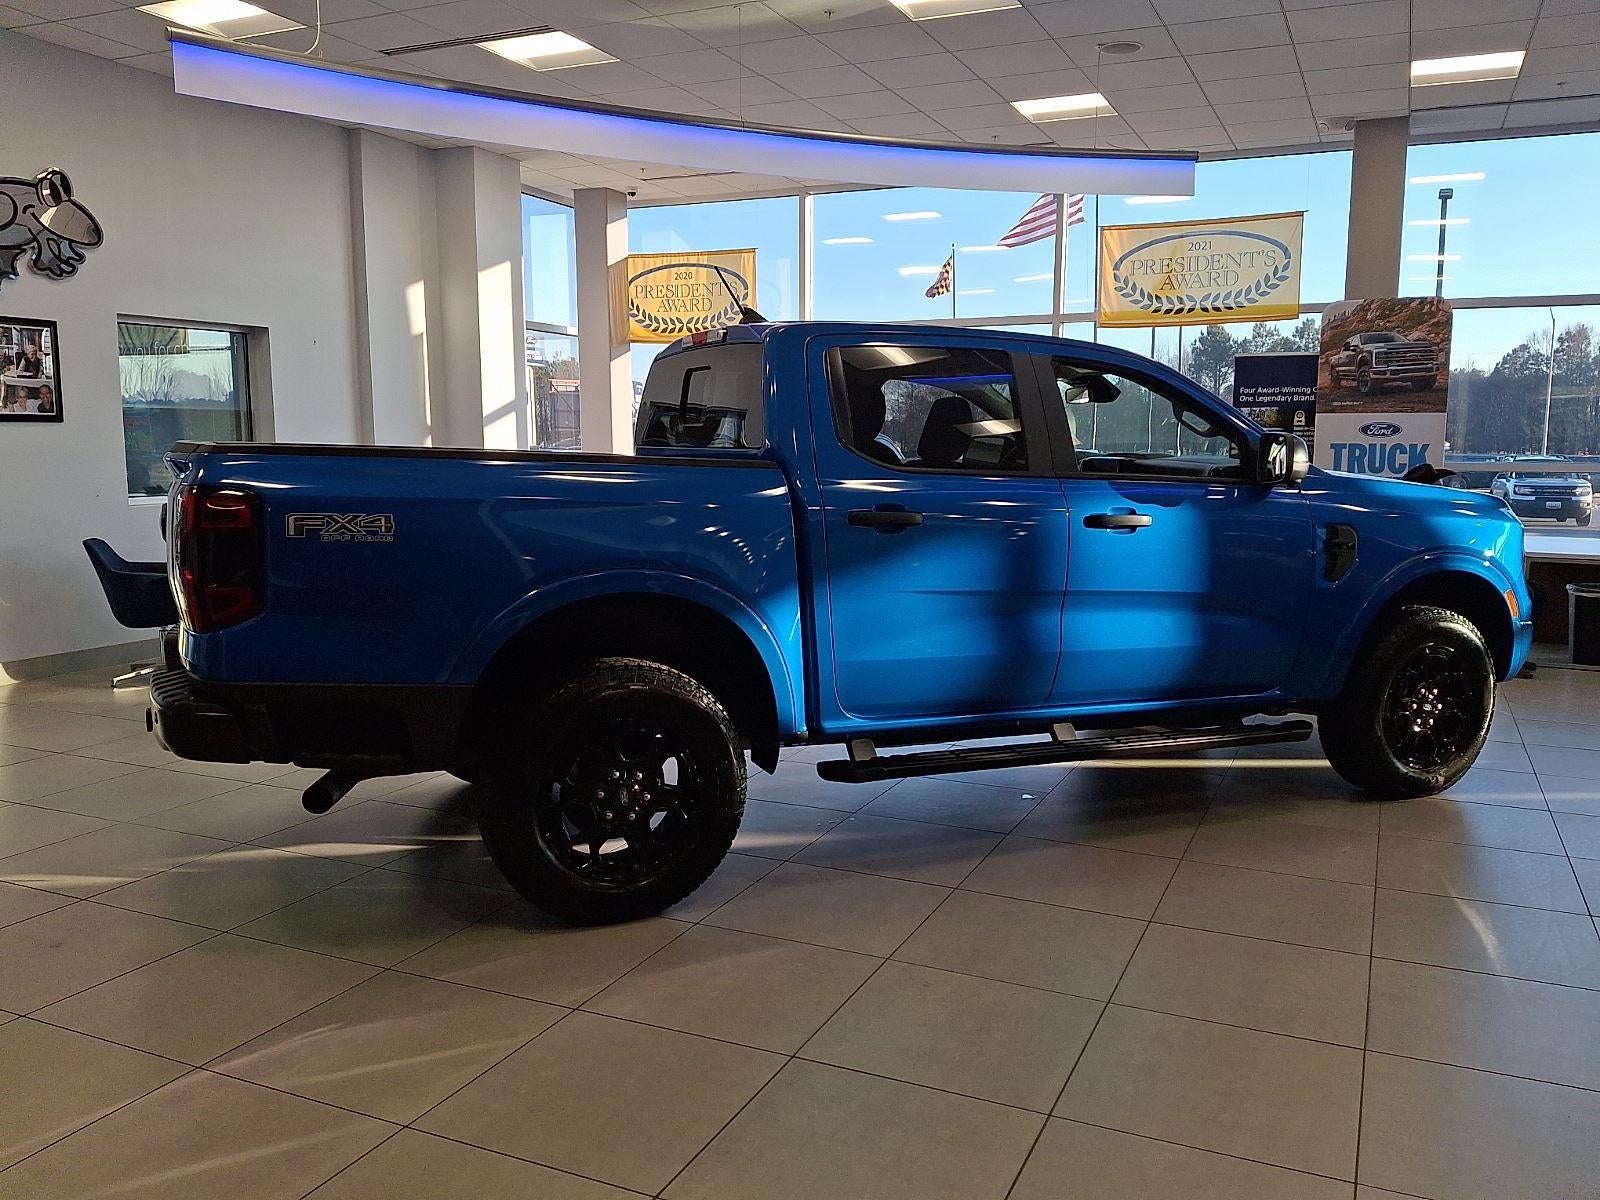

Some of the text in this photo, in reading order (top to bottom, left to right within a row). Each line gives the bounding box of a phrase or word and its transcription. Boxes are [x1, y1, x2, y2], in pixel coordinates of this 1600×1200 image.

[1188, 241, 1213, 252] 2021
[1130, 250, 1276, 277] PRESIDENT'S
[674, 272, 693, 281] 2020
[1159, 269, 1240, 291] AWARD
[634, 281, 738, 300] PRESIDENTS
[656, 298, 713, 313] AWARD
[1256, 386, 1311, 394] Award-Winning
[1255, 394, 1293, 403] Legendary
[1365, 423, 1395, 436] Ford
[1329, 442, 1431, 475] TRUCK
[285, 512, 395, 538] FX4
[320, 534, 394, 542] OFF ROAD
